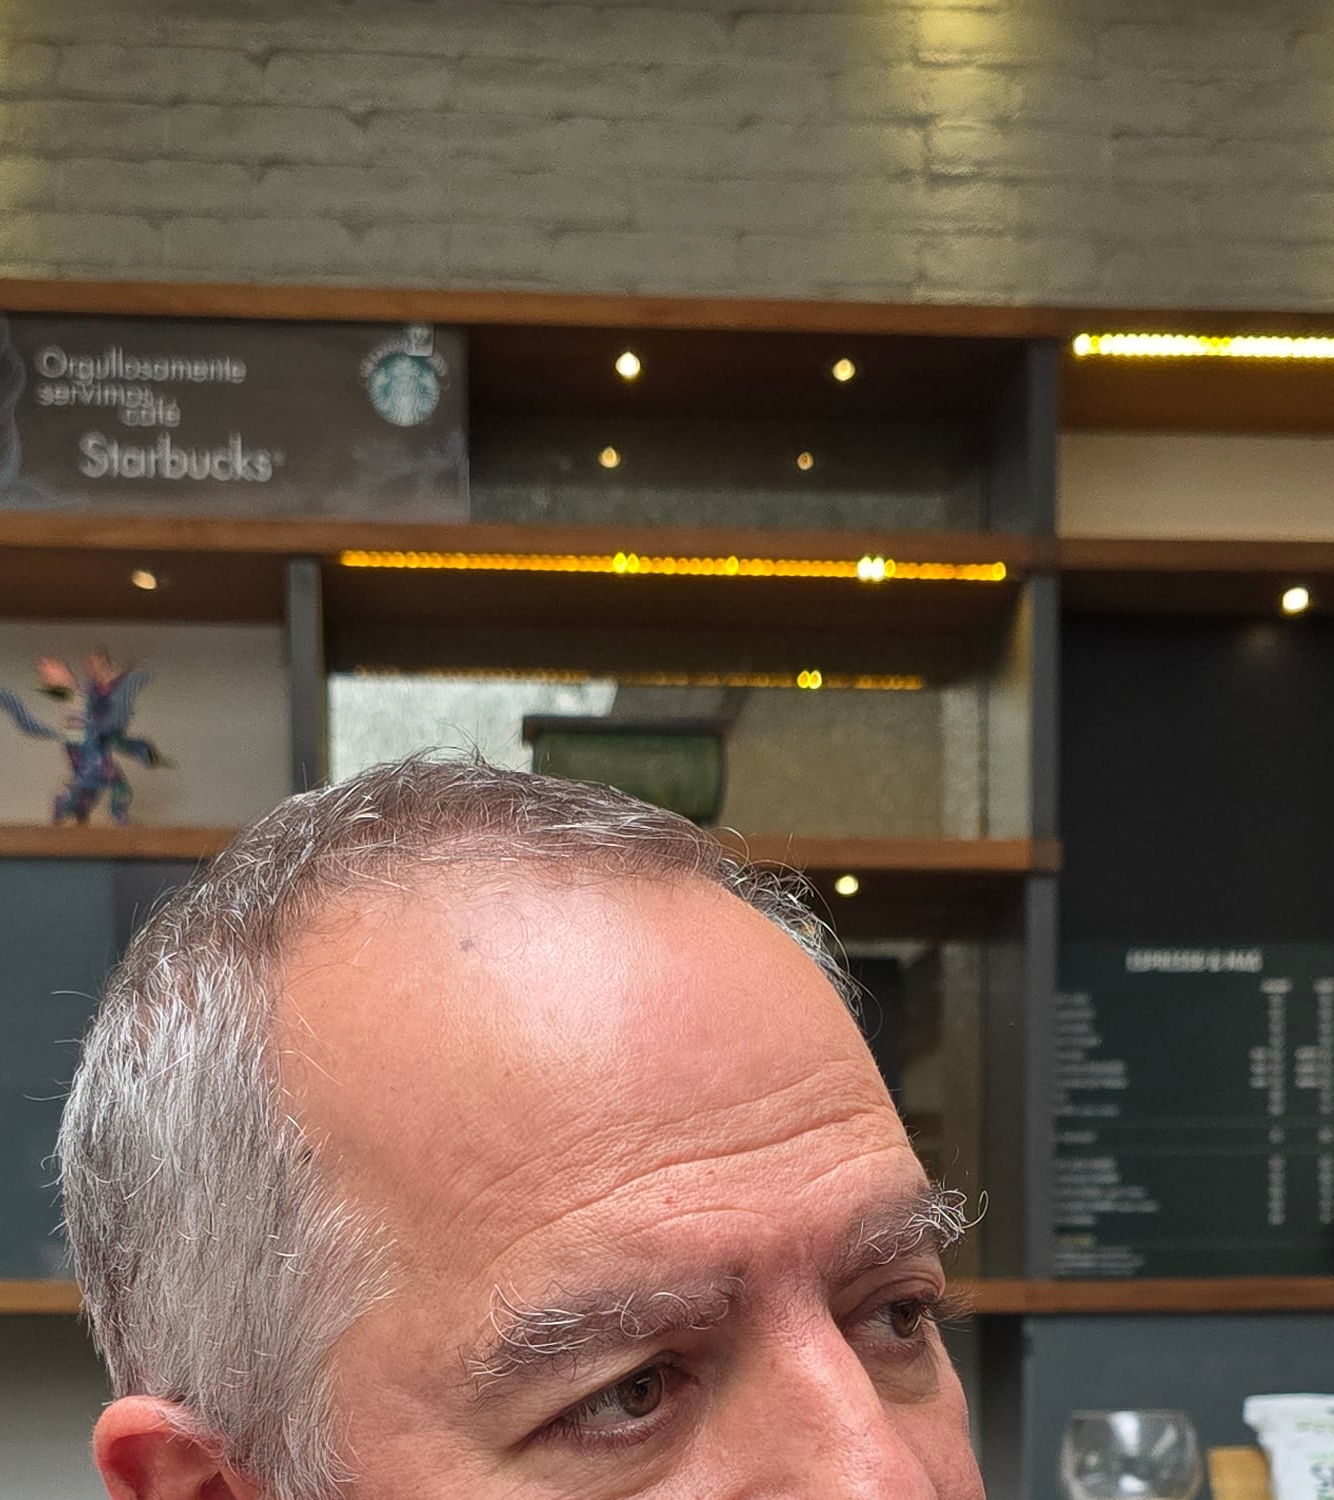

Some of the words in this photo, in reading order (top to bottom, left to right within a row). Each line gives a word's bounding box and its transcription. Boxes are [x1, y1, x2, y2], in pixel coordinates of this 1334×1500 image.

[35, 345, 247, 385] Orgullosamente
[36, 381, 154, 408] servimos
[79, 431, 273, 482] Starbucks
